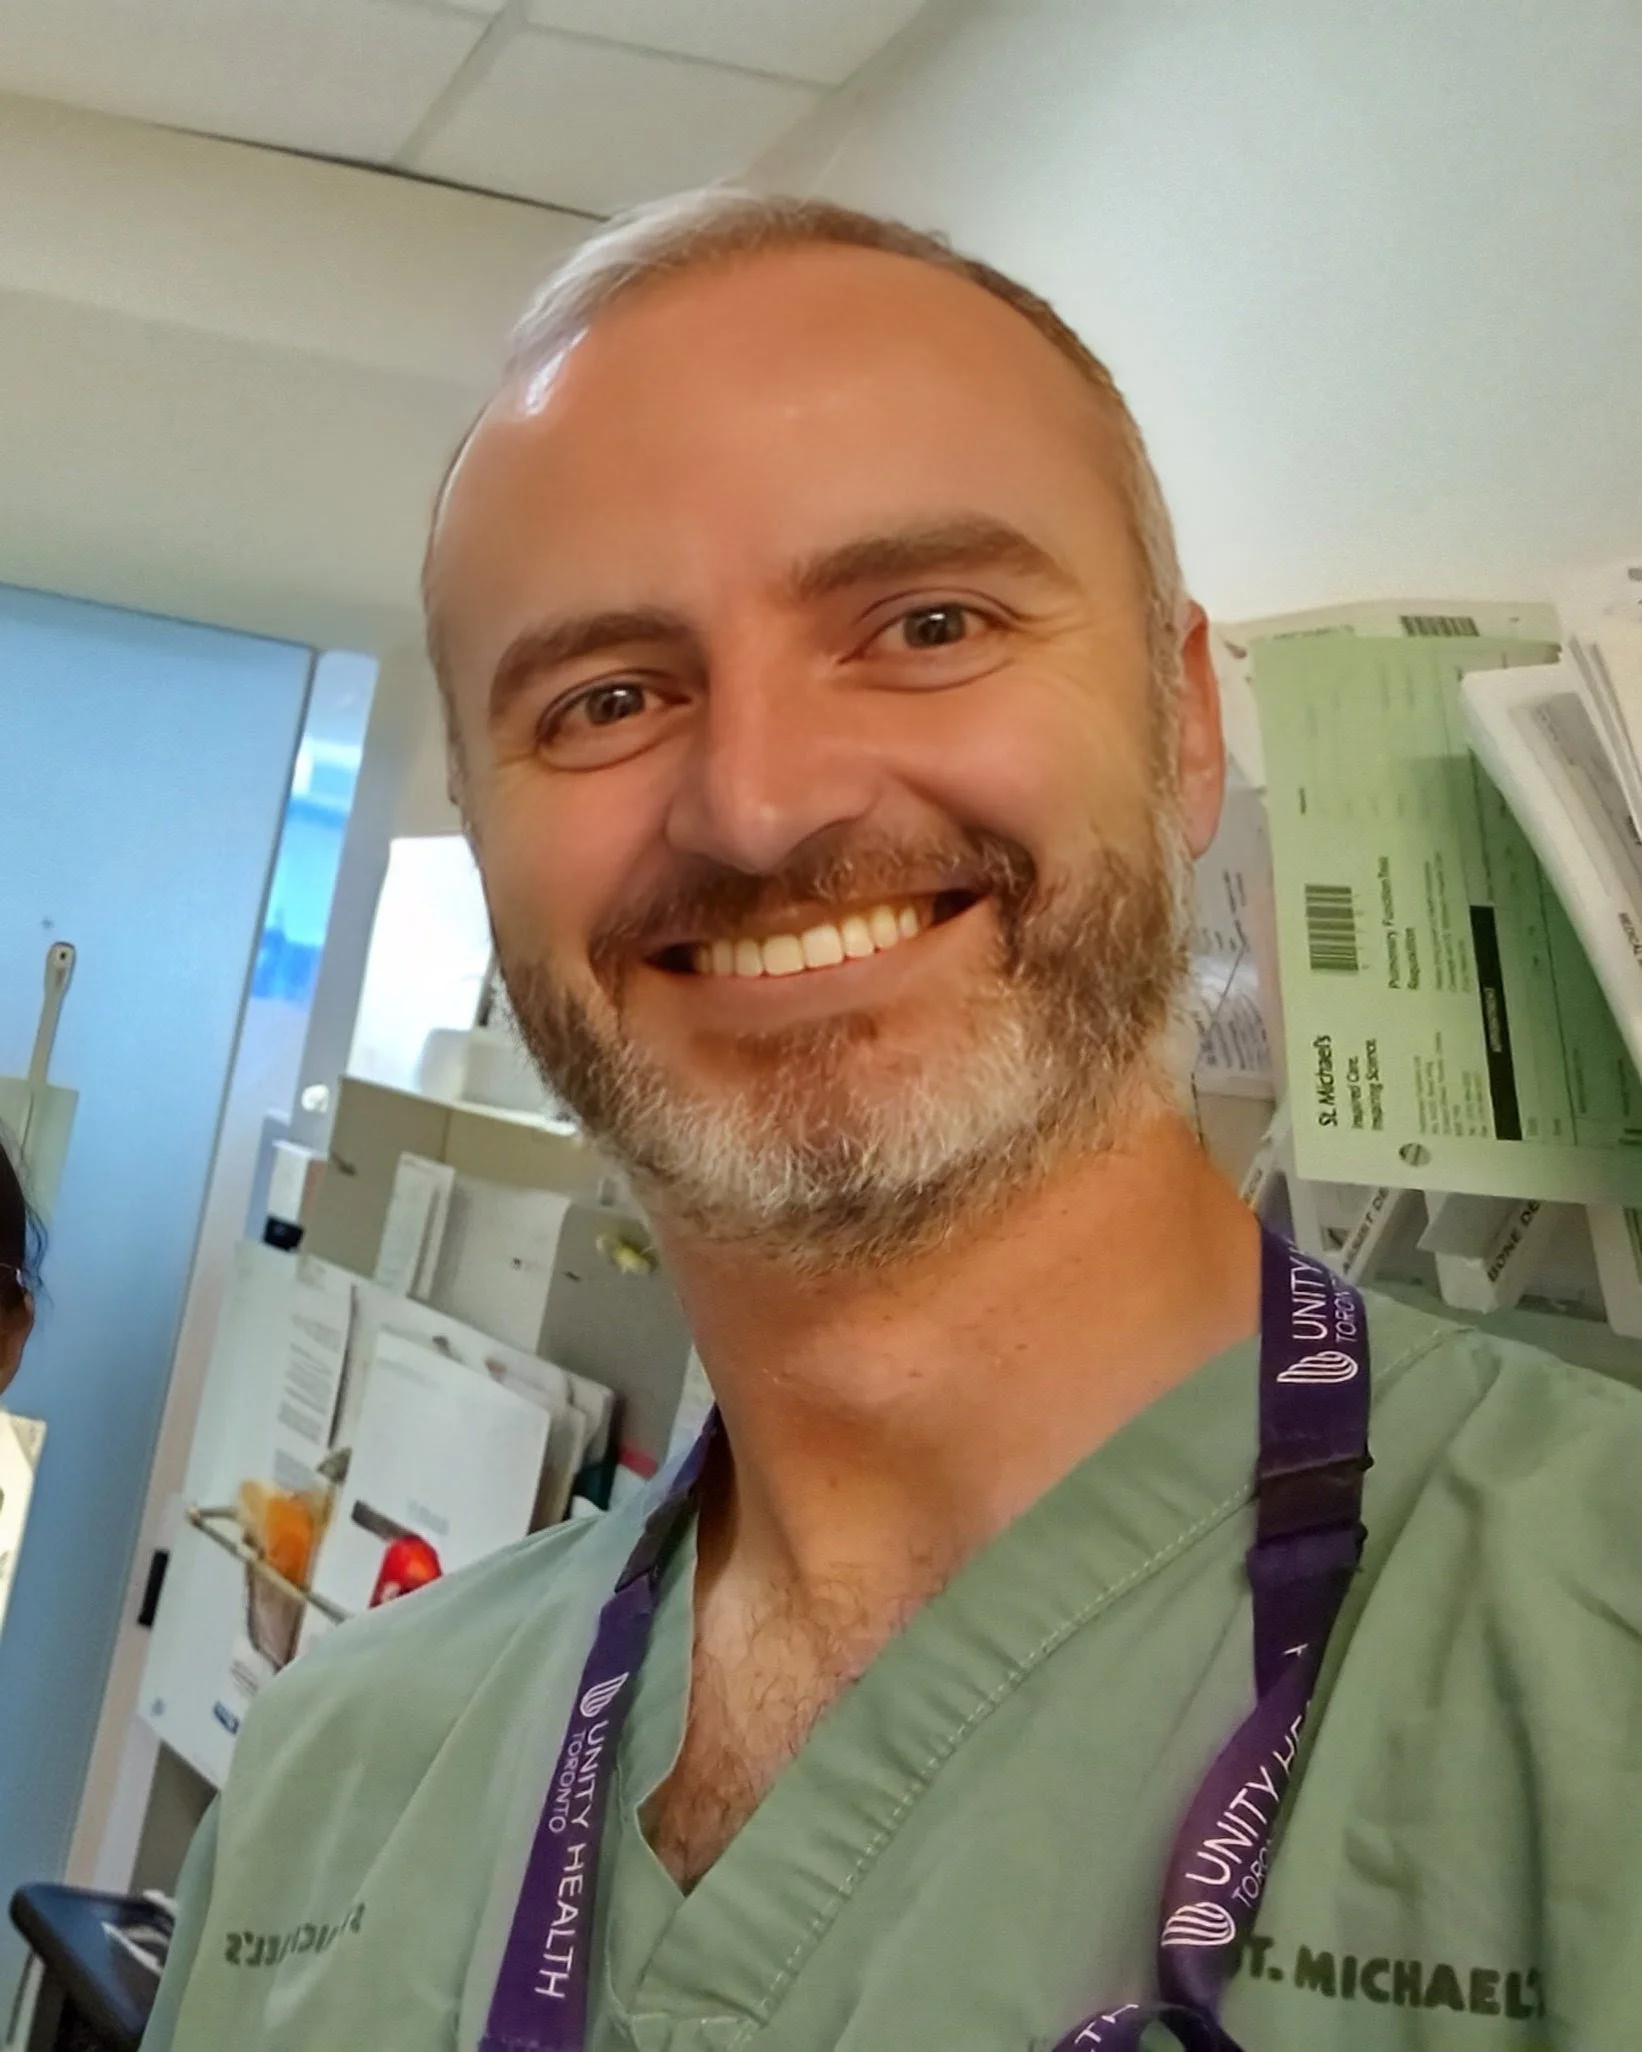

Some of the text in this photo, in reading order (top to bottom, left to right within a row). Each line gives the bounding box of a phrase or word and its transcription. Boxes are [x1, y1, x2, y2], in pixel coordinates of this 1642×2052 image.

[1312, 1035, 1335, 1106] Michael's
[1289, 1255, 1328, 1339] UNITY
[548, 1731, 586, 1834] TORONTO
[571, 1719, 610, 1829] UNITY
[1184, 1765, 1280, 1886] UNITY
[534, 1842, 587, 1999] HEALTH
[1293, 1943, 1547, 2020] MICHAEL'
